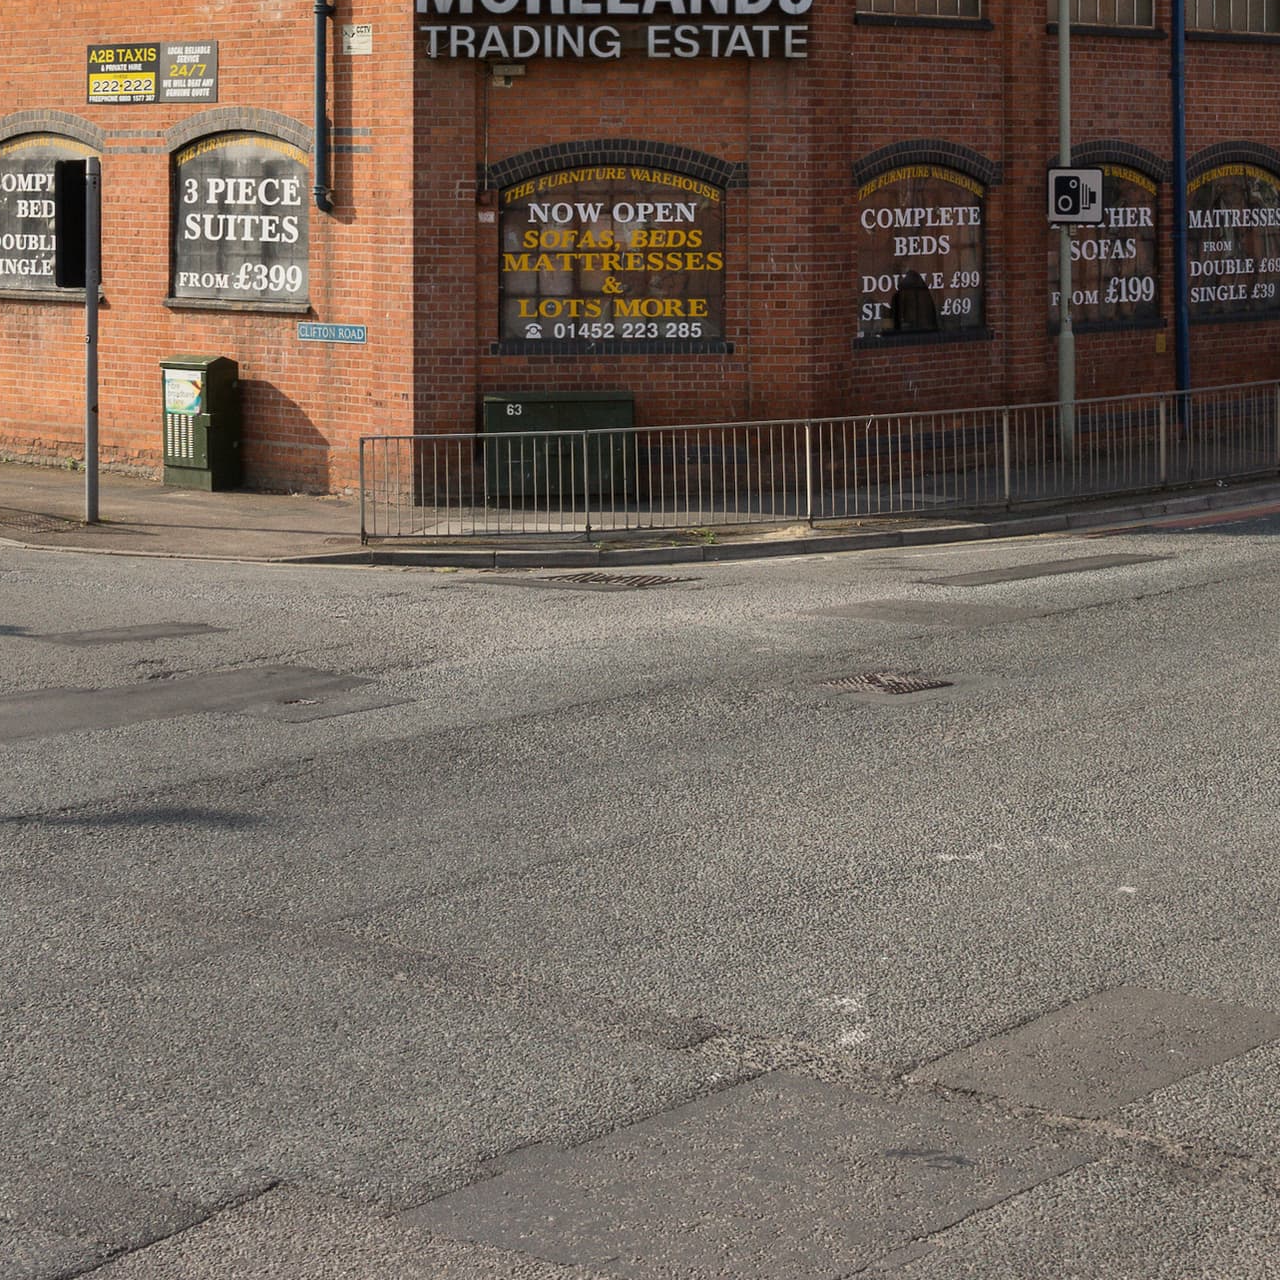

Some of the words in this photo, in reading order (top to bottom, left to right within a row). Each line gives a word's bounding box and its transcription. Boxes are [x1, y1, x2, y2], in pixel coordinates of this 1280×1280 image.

[420, 25, 621, 58] TRADING
[647, 24, 809, 58] ESTATE
[89, 50, 115, 63] A2B
[116, 48, 156, 62] TAXIS
[170, 64, 206, 77] 24/7
[183, 179, 198, 205] 3
[206, 177, 302, 206] PIECE
[504, 182, 536, 204] THE
[537, 168, 626, 192] FURNITURE
[630, 169, 721, 202] WAREHOUSE
[858, 183, 876, 201] THE
[877, 166, 929, 189] FURNITURE
[931, 167, 983, 198] WAREHOUSE
[16, 199, 56, 218] BED
[528, 203, 603, 223] NOW
[613, 203, 697, 223] OPEN
[860, 207, 981, 229] COMPLETE
[184, 214, 299, 243] SUITES
[523, 230, 622, 251] SOFAS,
[630, 230, 703, 249] BEDS
[893, 235, 951, 256] BEDS
[1070, 238, 1137, 261] SOFAS
[1203, 241, 1232, 253] FROM
[502, 252, 724, 272] MATTRESSES
[1190, 258, 1255, 277] DOUBLE
[178, 272, 230, 289] FROM
[232, 263, 303, 292] £399
[602, 276, 623, 294] &
[950, 271, 980, 289] £99
[1051, 290, 1099, 306] FOM
[1105, 276, 1155, 303] £199
[1190, 284, 1248, 303] SINGLE
[1251, 283, 1275, 299] £39
[517, 298, 601, 318] LOTS
[613, 298, 708, 318] MORE
[940, 298, 971, 315] £69
[299, 326, 335, 338] CLIFTON
[338, 328, 364, 340] ROAD
[553, 323, 615, 338] 01452
[622, 323, 659, 338] 223
[665, 322, 702, 338] 285
[506, 404, 522, 416] 63
